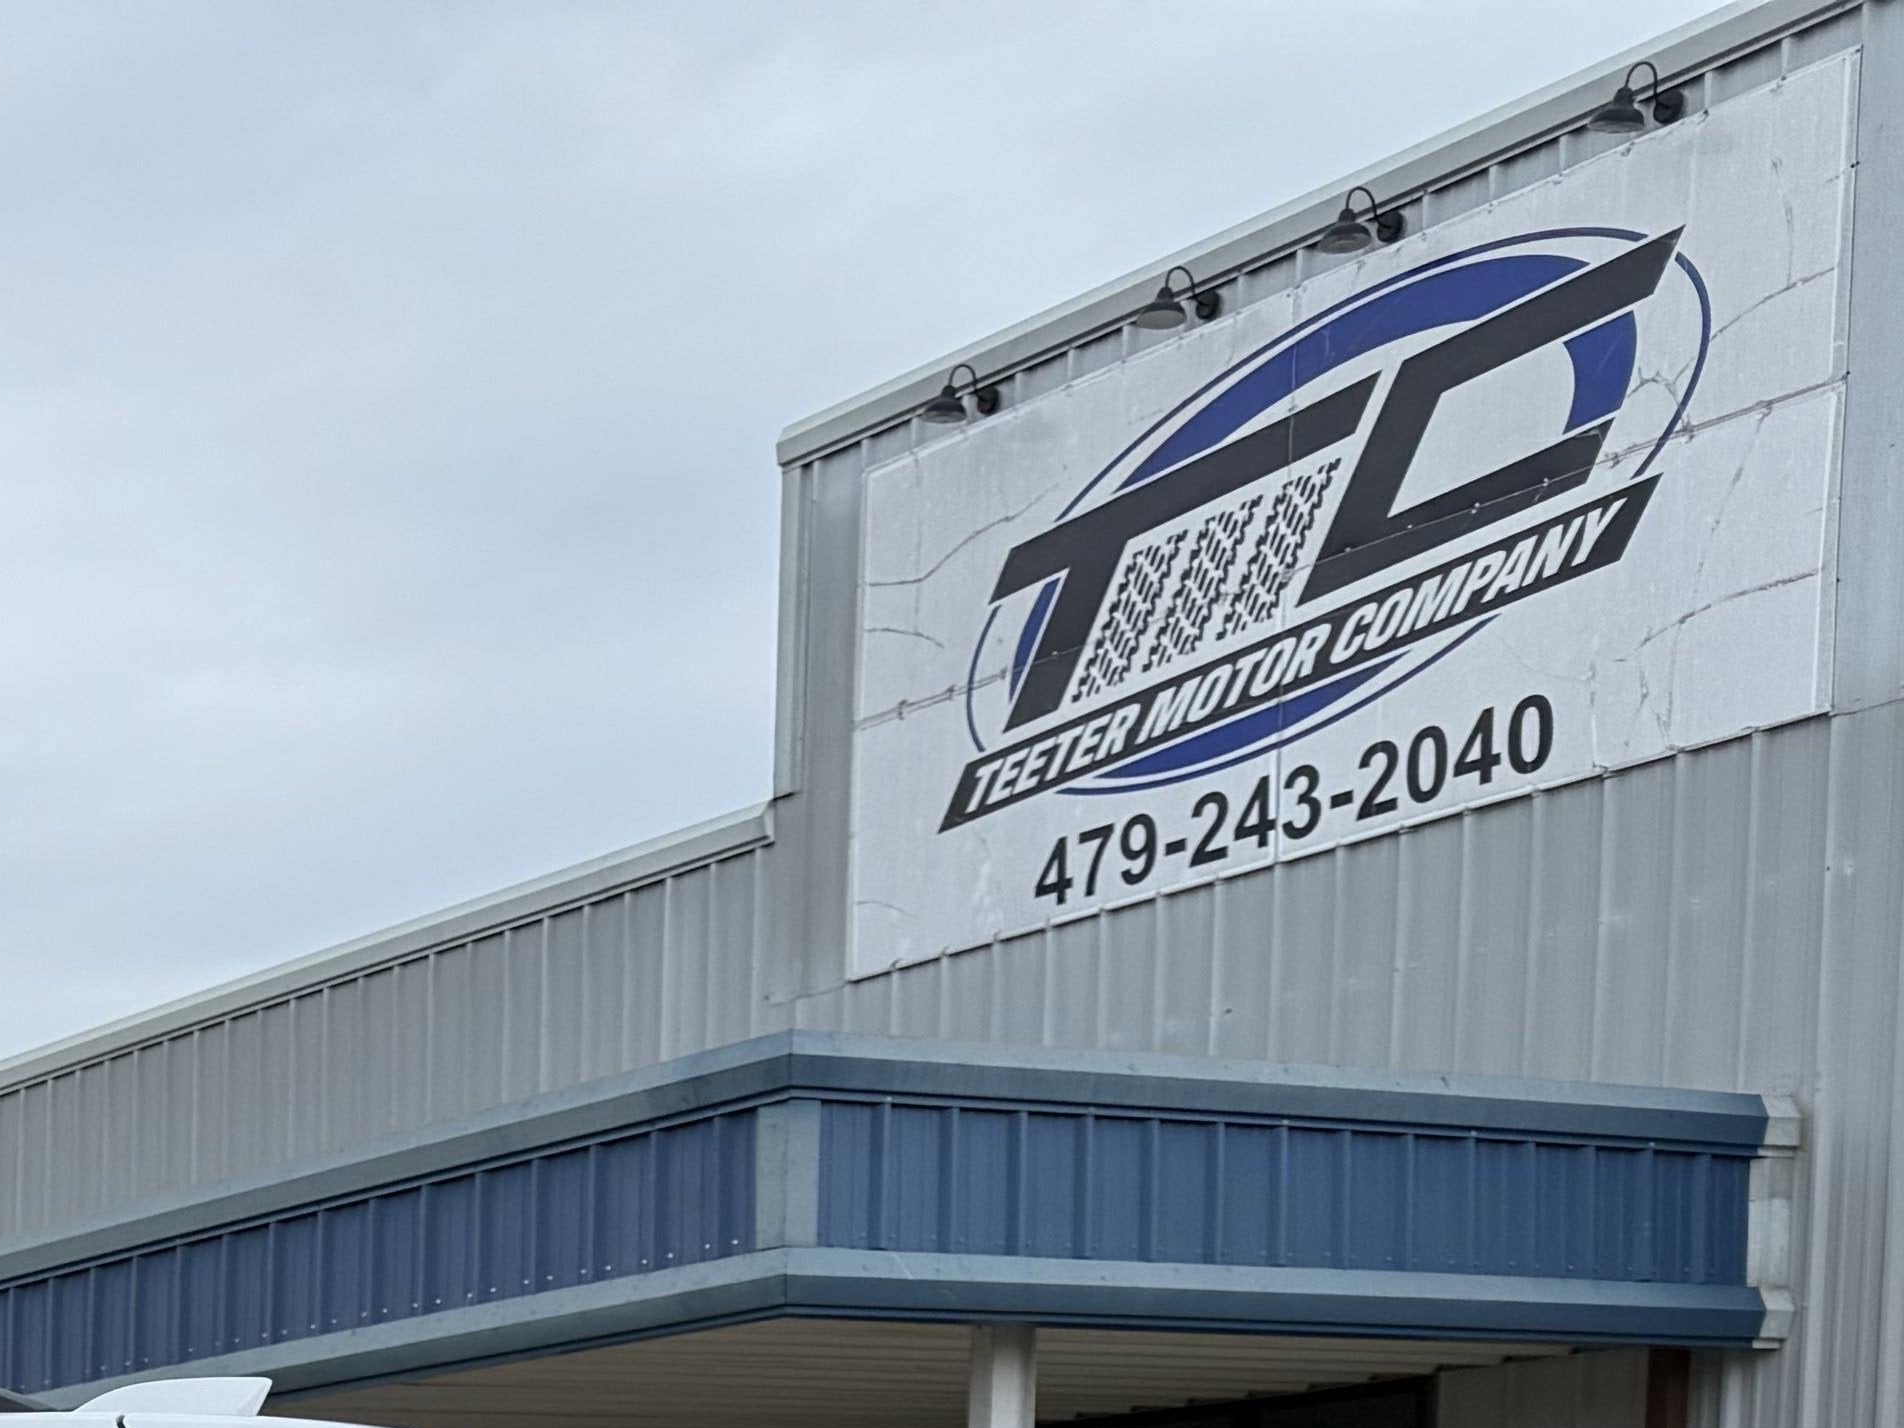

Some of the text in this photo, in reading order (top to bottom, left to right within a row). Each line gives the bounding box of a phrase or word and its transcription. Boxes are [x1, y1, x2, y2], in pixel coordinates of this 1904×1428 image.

[964, 497, 1629, 814] TEETER MOTOR COMPANY
[1034, 693, 1555, 906] 479-243-2040
